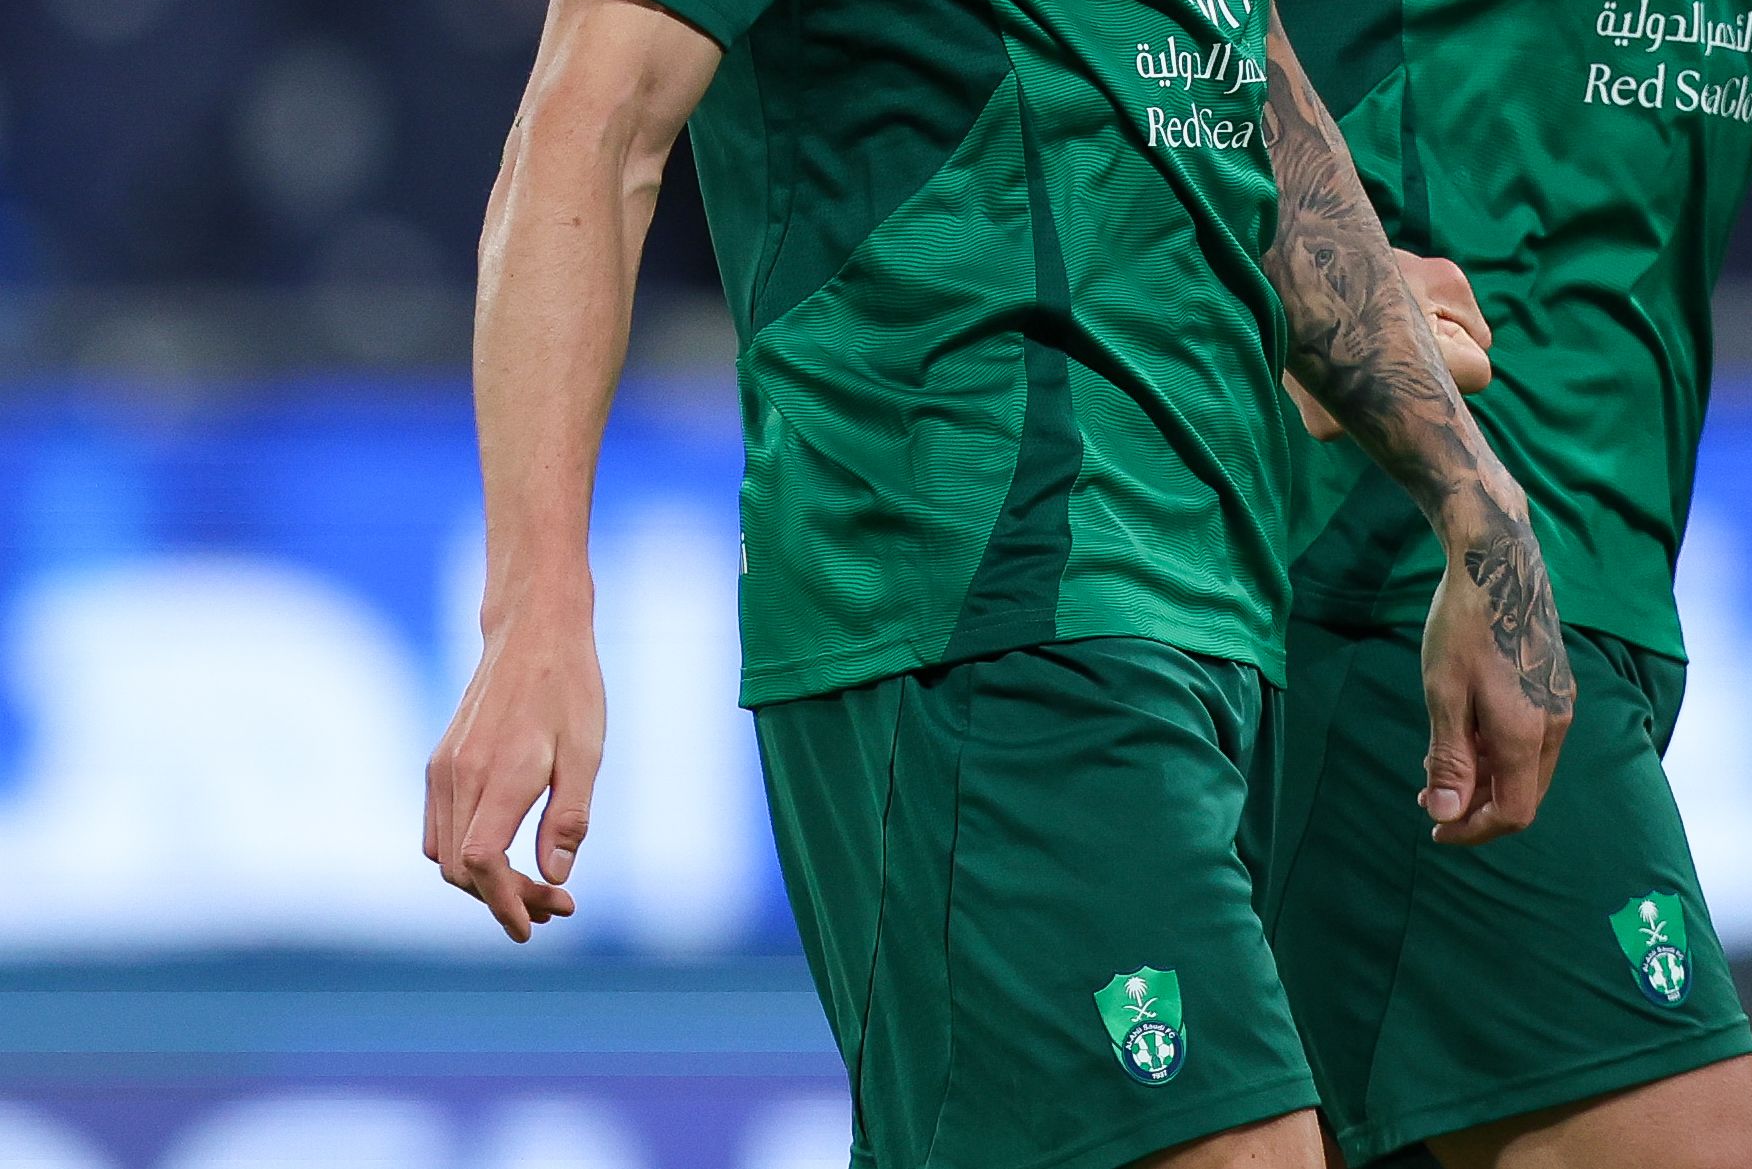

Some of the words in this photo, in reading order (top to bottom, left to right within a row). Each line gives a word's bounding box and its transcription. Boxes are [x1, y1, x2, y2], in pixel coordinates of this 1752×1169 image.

[1584, 62, 1666, 109] Red
[1146, 102, 1202, 148] Red
[1200, 108, 1254, 150] Sea
